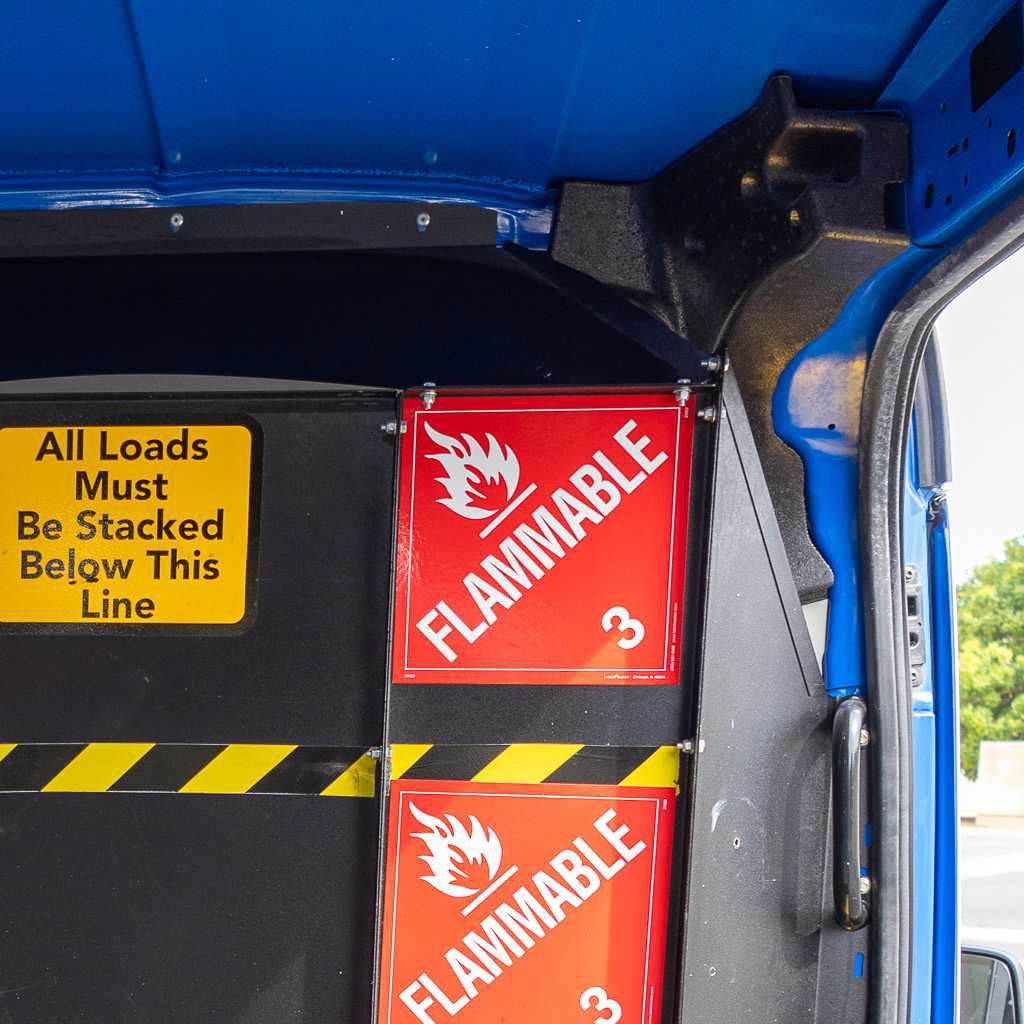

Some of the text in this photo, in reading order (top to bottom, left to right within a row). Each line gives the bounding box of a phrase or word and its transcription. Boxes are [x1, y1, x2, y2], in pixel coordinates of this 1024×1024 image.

[35, 428, 209, 461] All Loads
[75, 470, 169, 501] Must
[17, 508, 224, 540] Be Stacked
[415, 418, 669, 663] FLAMMABLE
[20, 547, 220, 580] Below This
[81, 588, 156, 619] Line
[601, 606, 645, 650] 3
